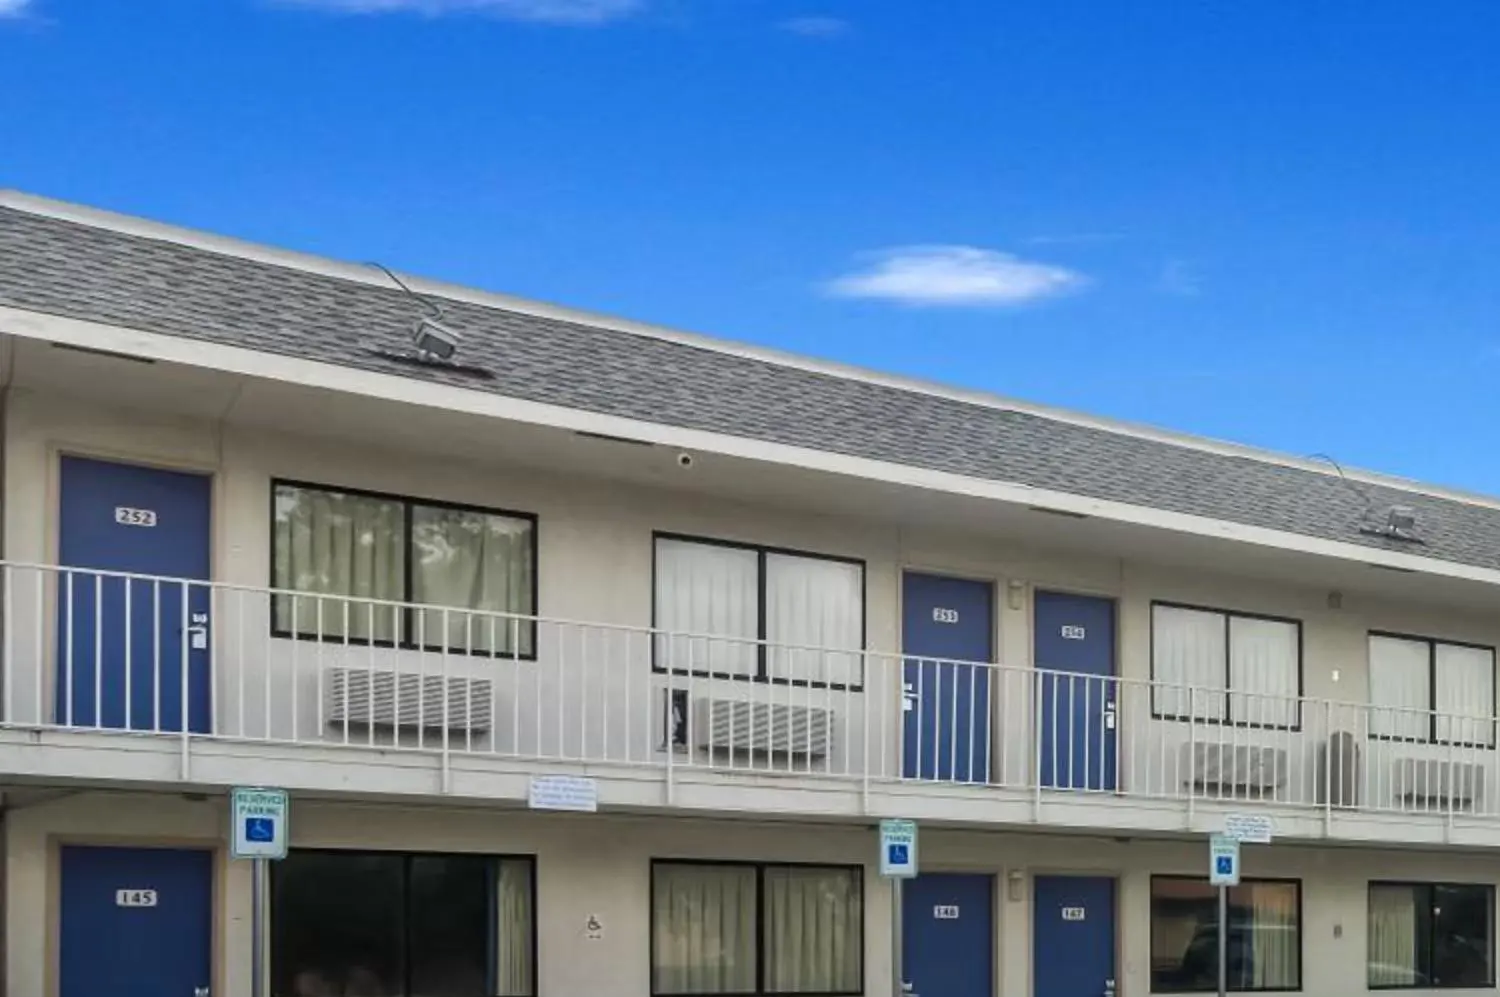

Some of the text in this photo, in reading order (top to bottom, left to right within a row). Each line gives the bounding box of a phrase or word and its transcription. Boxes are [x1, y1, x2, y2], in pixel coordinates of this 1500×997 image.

[120, 509, 153, 525] 252
[238, 793, 284, 805] RESERVED
[240, 805, 280, 816] PARKING
[122, 890, 153, 905] 145
